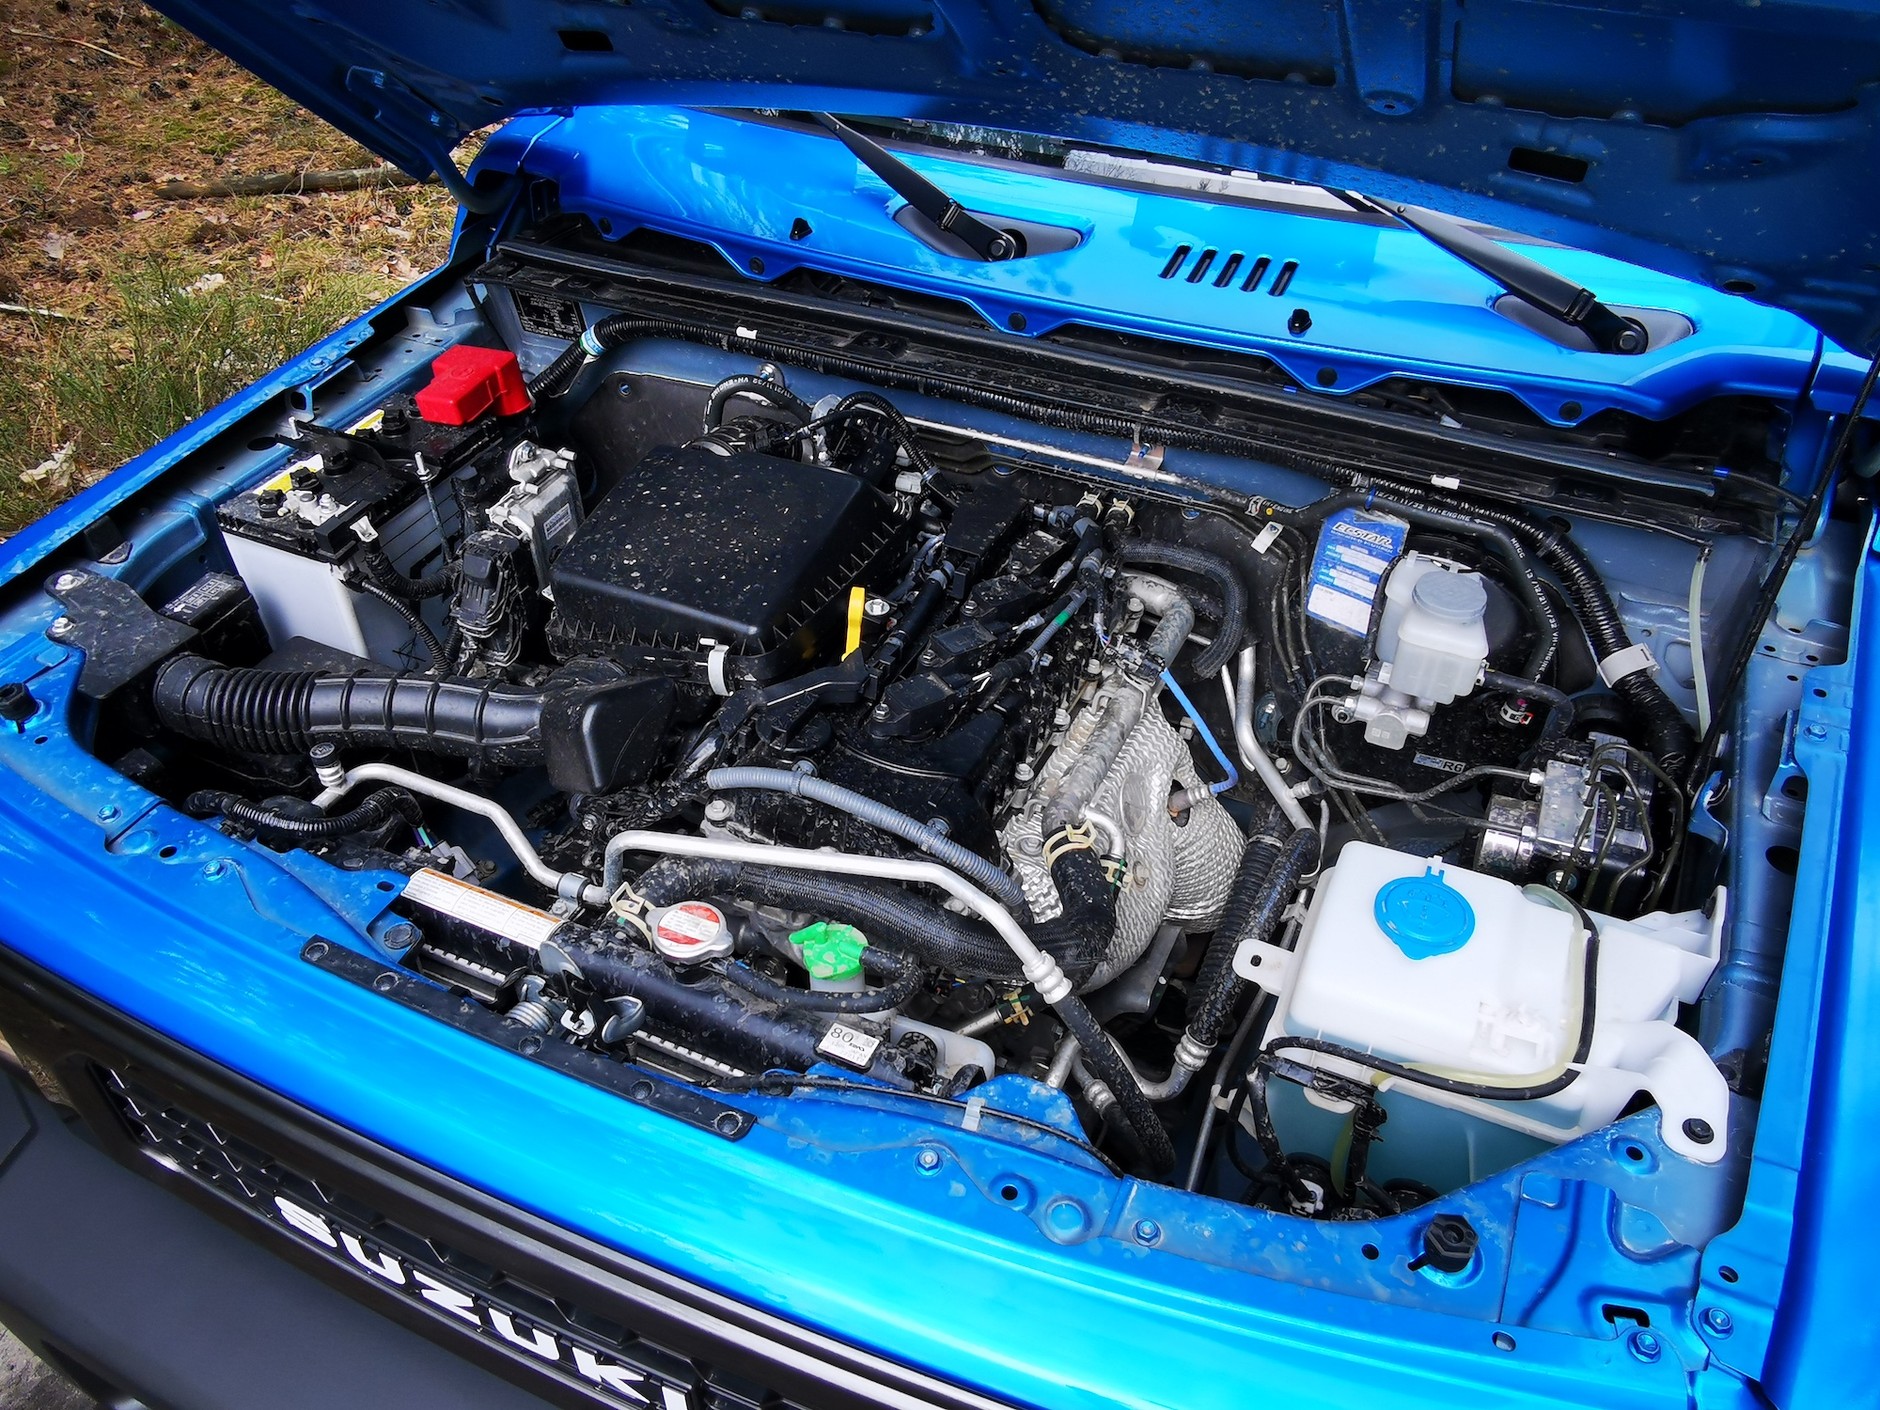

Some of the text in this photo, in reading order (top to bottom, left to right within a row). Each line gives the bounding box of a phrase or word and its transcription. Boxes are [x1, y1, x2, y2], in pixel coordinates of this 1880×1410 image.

[1333, 522, 1393, 548] ECSTAR
[830, 1026, 855, 1043] 80
[274, 1195, 690, 1410] SUZUKI
